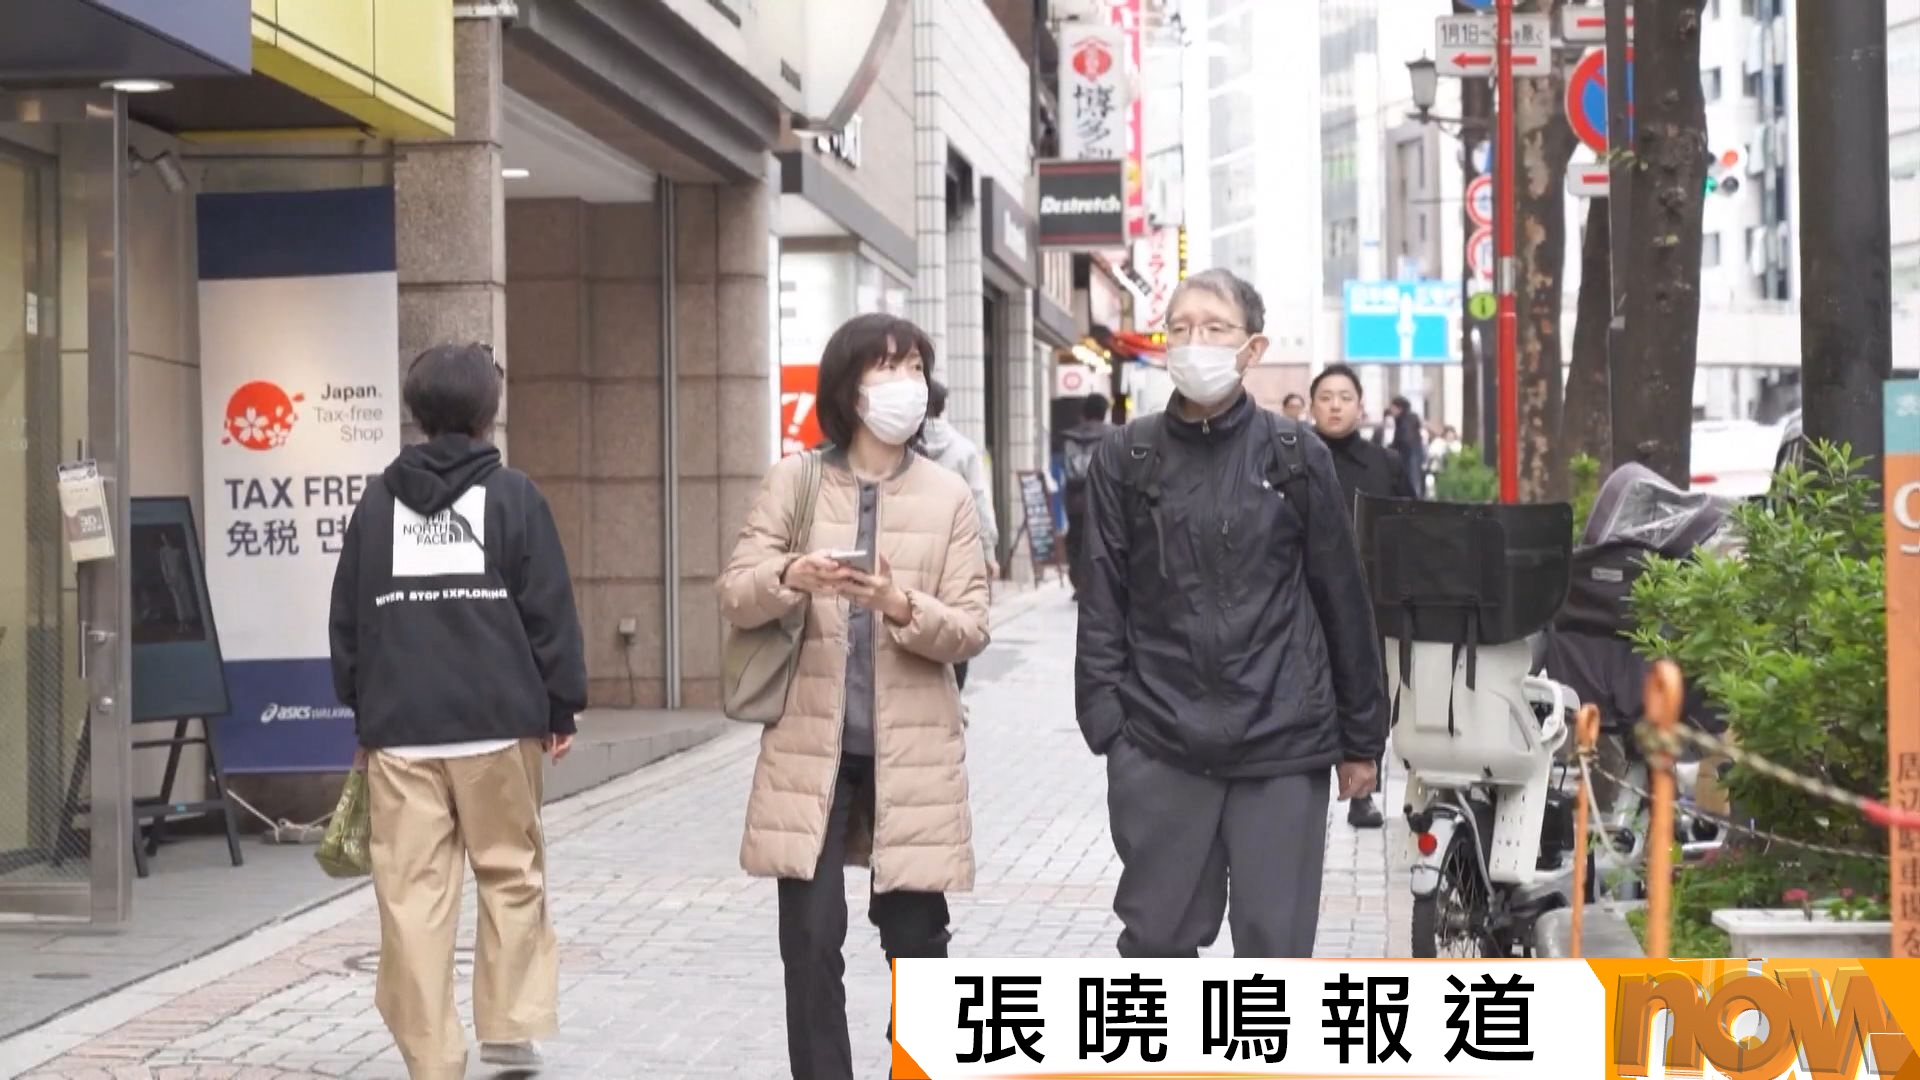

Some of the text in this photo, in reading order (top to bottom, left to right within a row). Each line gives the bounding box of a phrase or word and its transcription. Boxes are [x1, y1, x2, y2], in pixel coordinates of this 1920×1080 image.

[314, 405, 383, 423] Tax-free
[340, 425, 383, 444] Shop
[224, 476, 294, 510] TAX
[226, 519, 299, 557] 免税
[277, 705, 311, 720] asics
